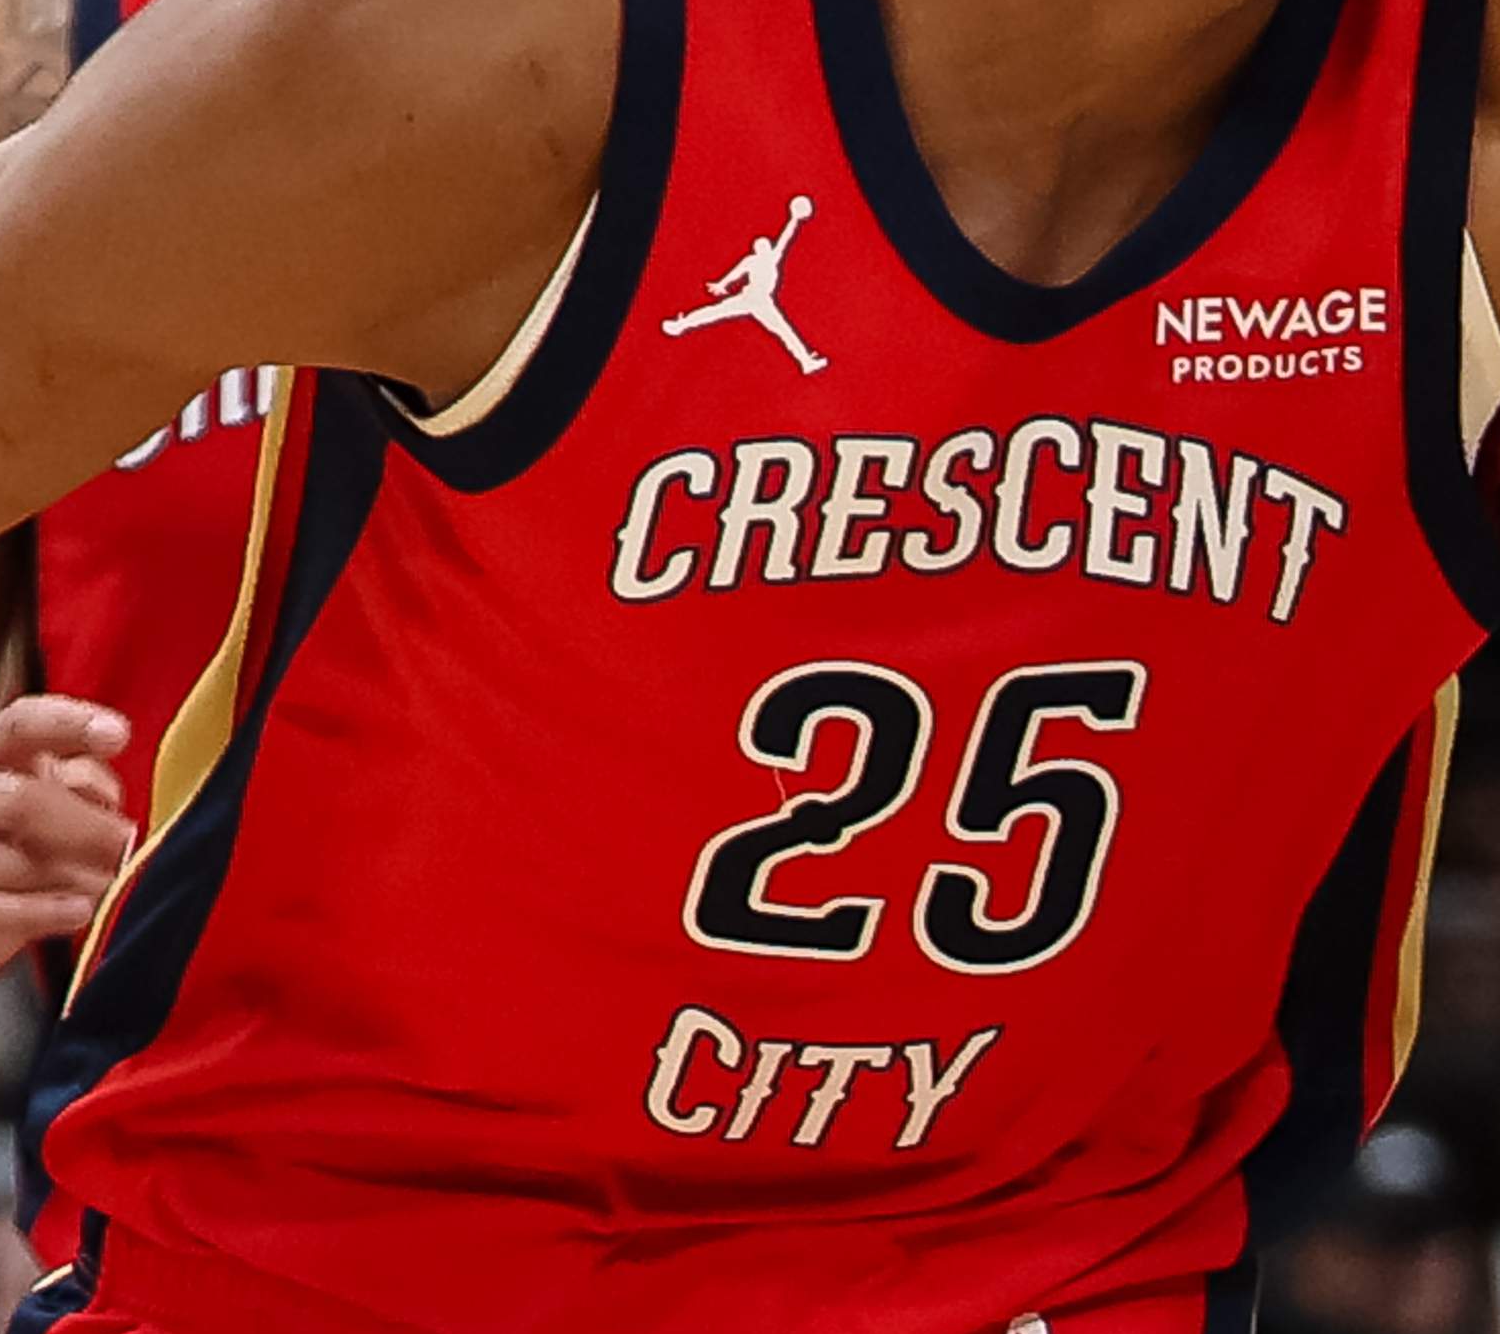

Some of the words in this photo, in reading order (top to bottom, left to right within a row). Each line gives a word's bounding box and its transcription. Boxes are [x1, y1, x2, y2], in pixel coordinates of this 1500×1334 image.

[1155, 287, 1387, 346] NEWAGE
[1171, 345, 1363, 384] PRODUCTS
[609, 417, 1349, 623] CRESCENT
[682, 661, 1148, 975] 25
[642, 1005, 1004, 1151] CITY
